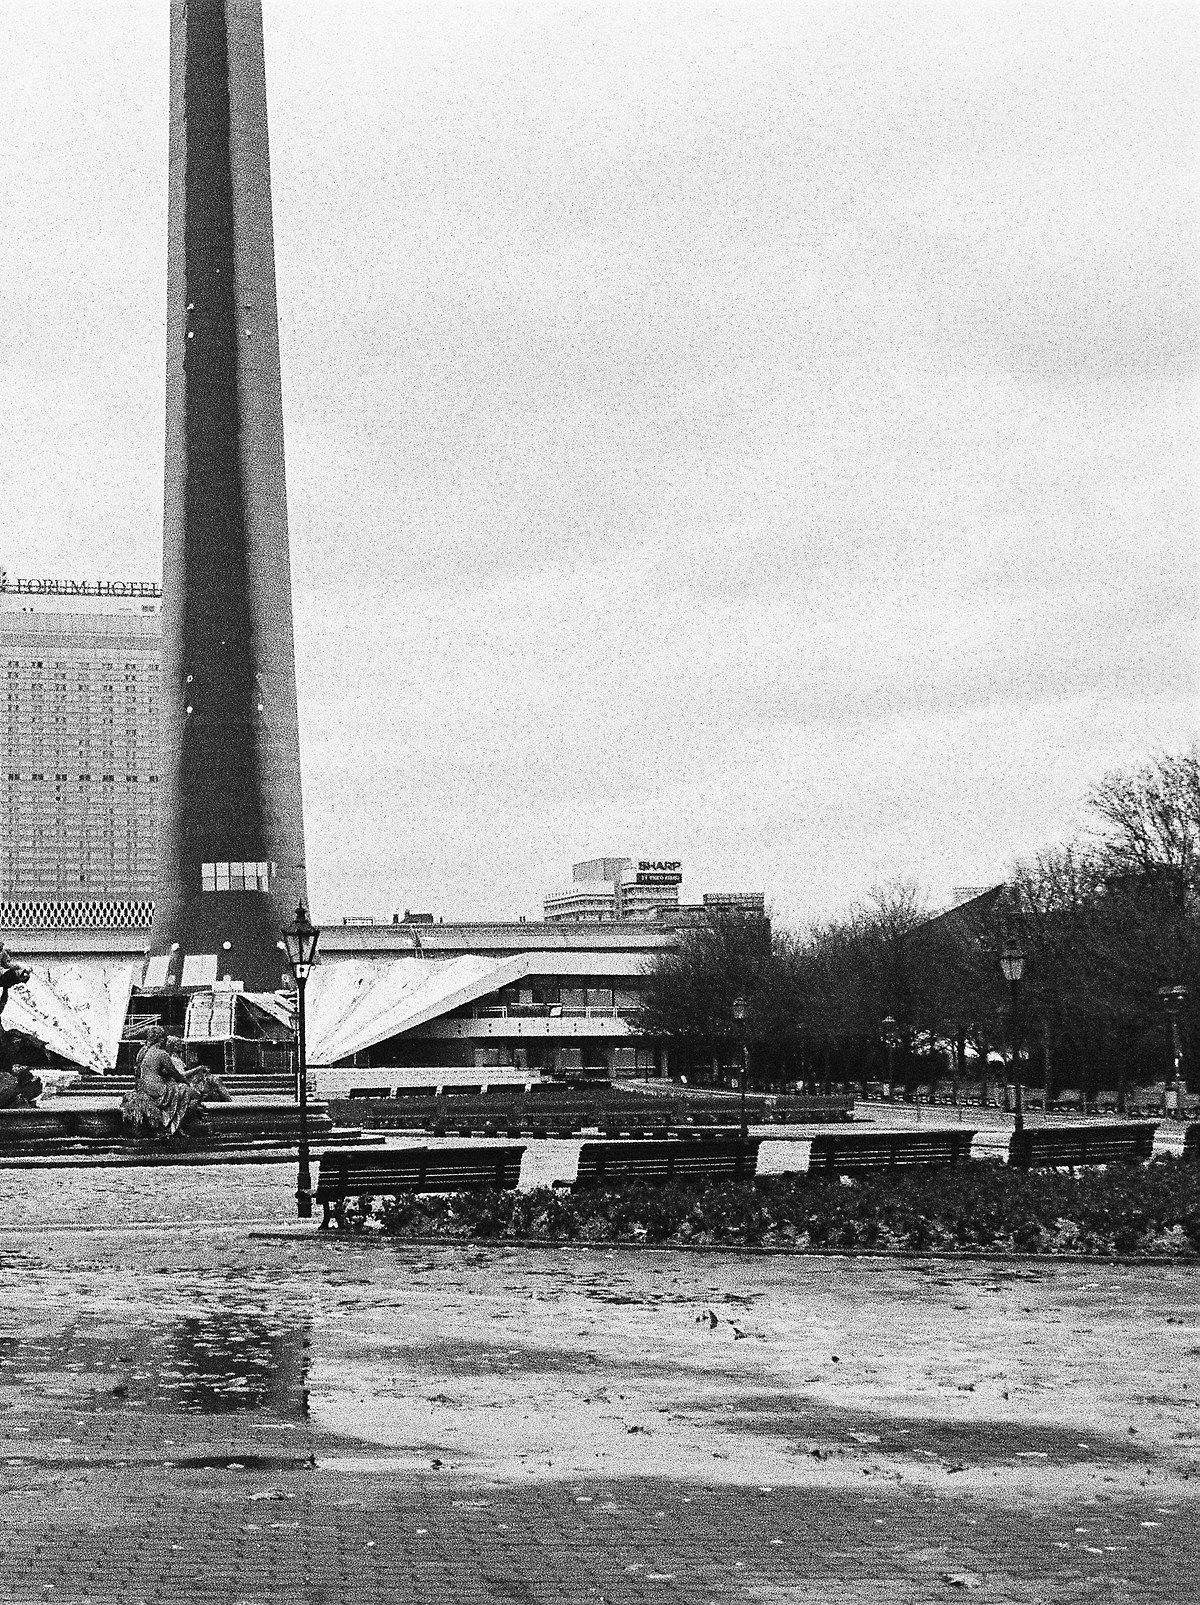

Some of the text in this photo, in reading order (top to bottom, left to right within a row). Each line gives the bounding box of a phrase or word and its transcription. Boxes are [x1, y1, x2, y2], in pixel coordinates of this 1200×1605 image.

[17, 578, 163, 597] FORUM HOTEL
[638, 861, 681, 871] SHARP
